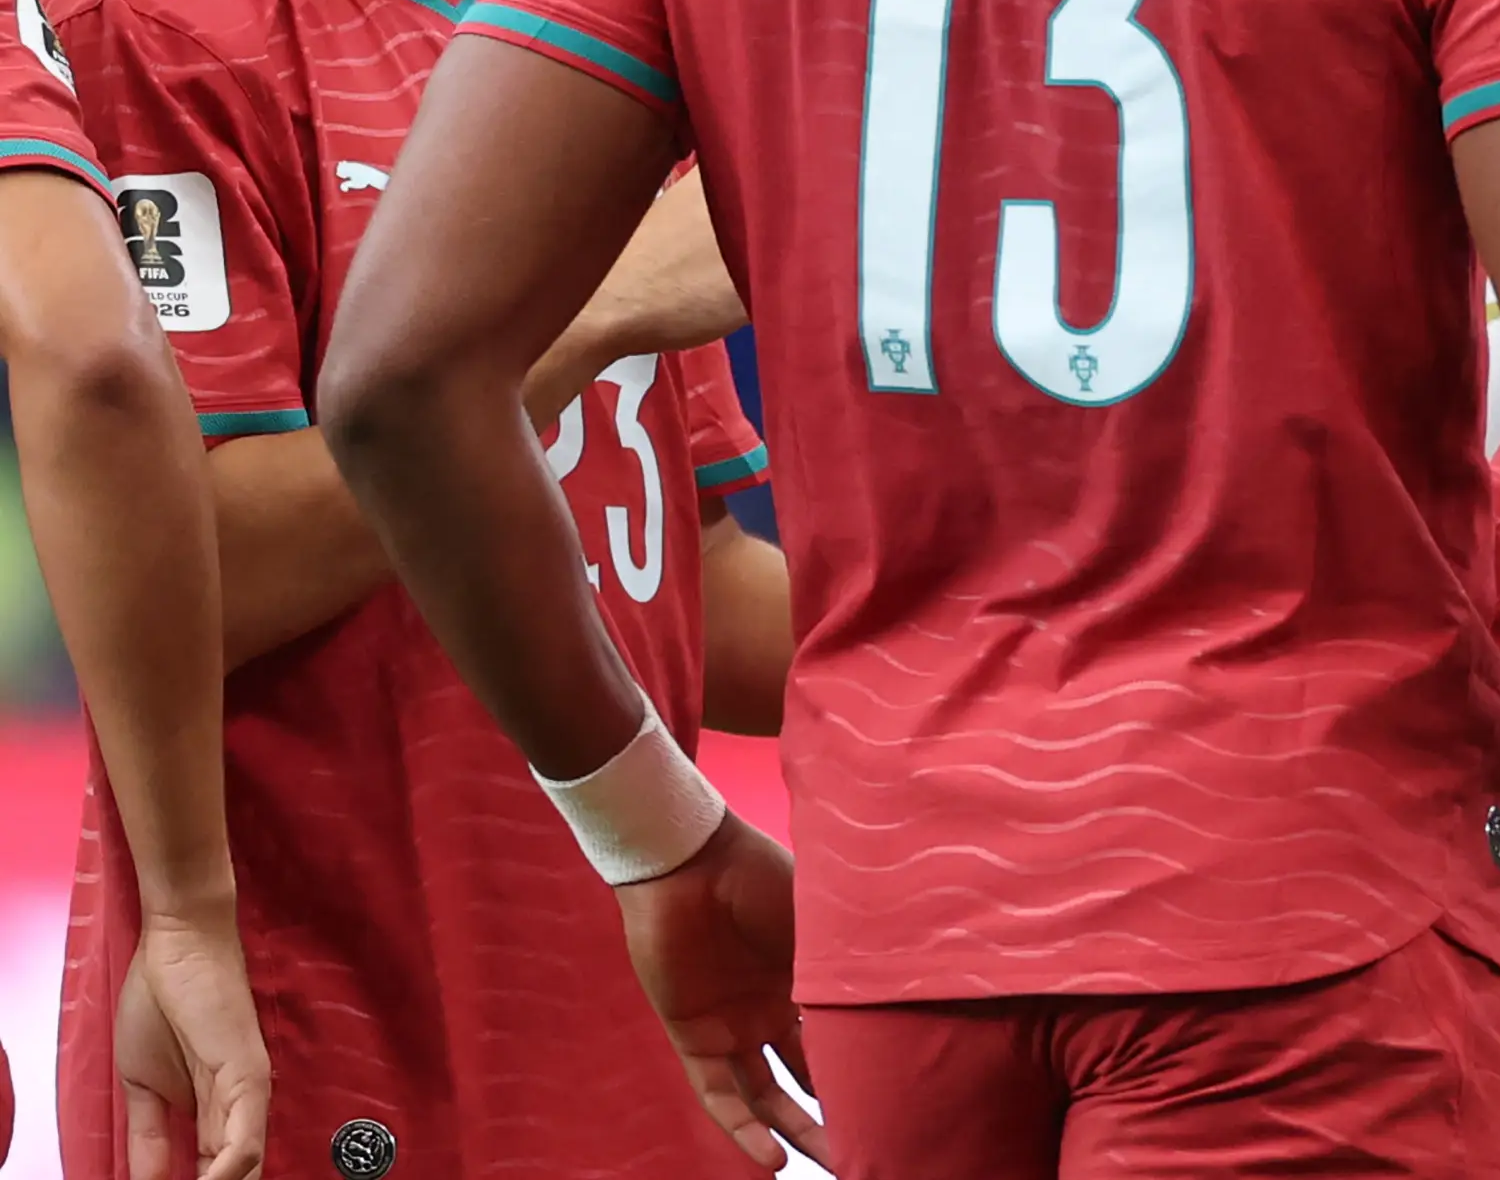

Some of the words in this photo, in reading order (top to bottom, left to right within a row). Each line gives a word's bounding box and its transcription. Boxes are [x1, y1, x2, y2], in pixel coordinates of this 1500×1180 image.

[139, 267, 169, 280] FIFA
[167, 292, 188, 301] CUP
[155, 303, 191, 317] 26
